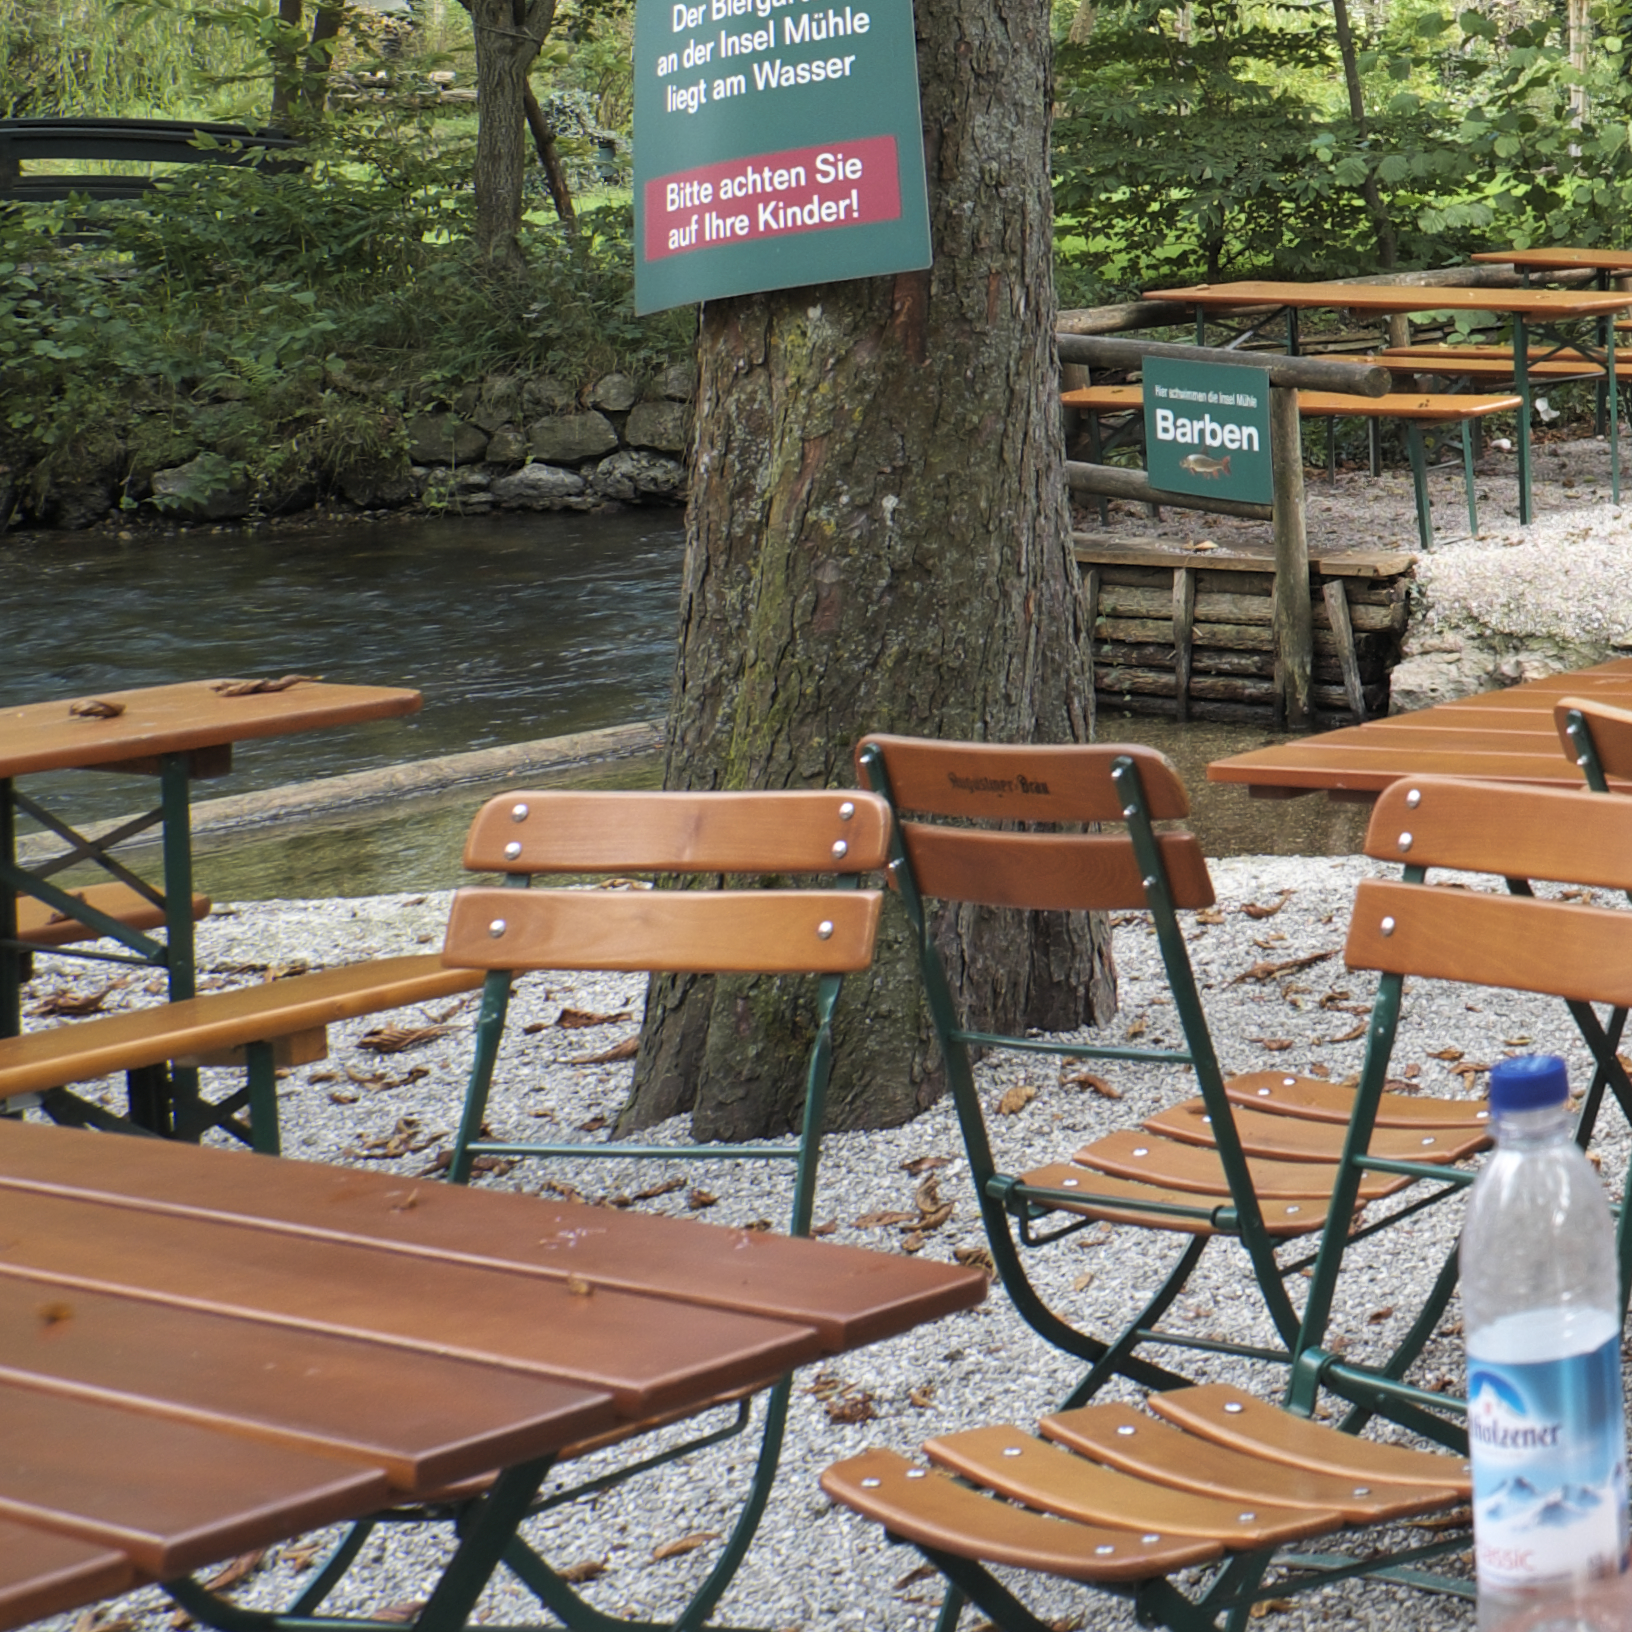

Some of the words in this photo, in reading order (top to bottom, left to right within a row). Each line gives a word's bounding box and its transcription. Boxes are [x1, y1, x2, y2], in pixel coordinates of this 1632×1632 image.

[656, 52, 679, 77] an
[682, 38, 715, 69] der
[720, 19, 776, 58] Insel
[784, 6, 871, 46] Mühle
[672, 3, 707, 33] Der
[666, 79, 707, 114] liegt
[712, 73, 747, 100] am
[752, 54, 856, 91] Wasser
[666, 181, 713, 212] Bitte
[719, 165, 806, 200] achten
[815, 153, 863, 184] Sie
[668, 214, 699, 250] auf
[704, 211, 750, 242] Ihre
[757, 188, 859, 232] Kinder!
[1219, 391, 1236, 406] Insel
[1155, 408, 1260, 452] Barben
